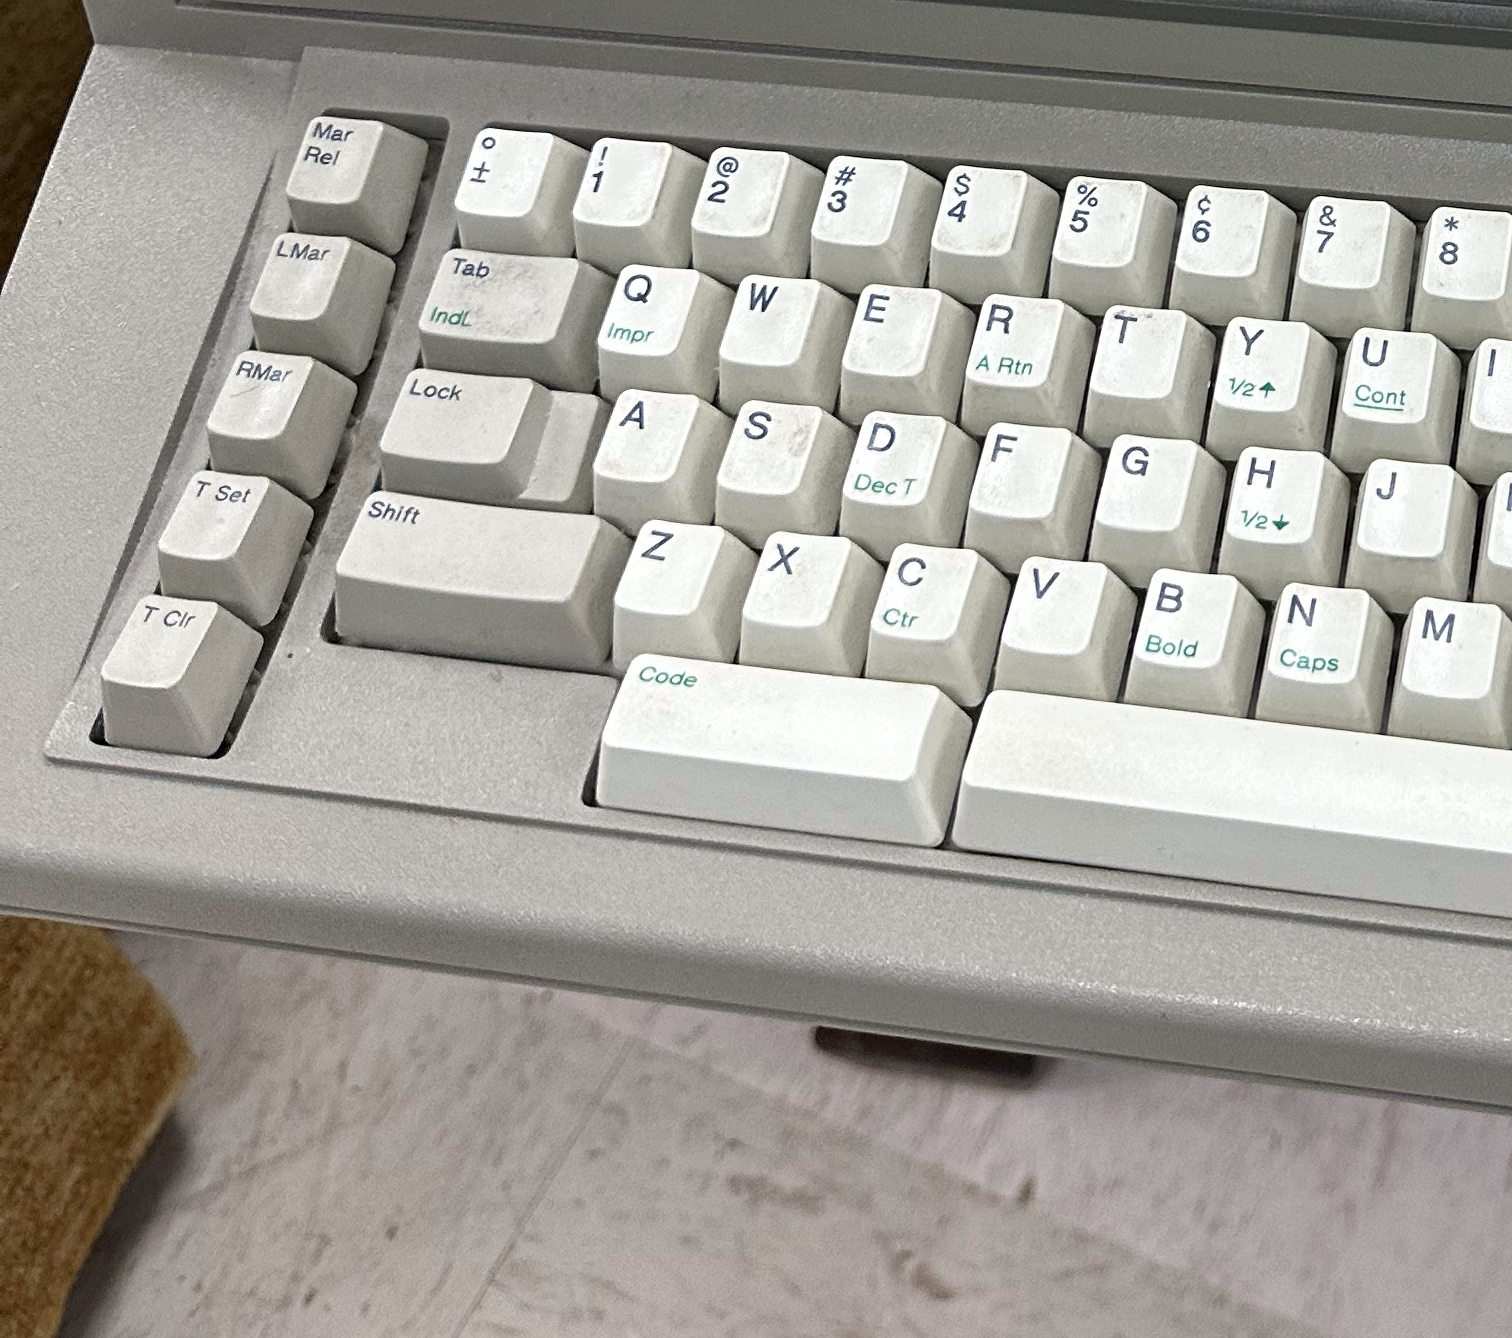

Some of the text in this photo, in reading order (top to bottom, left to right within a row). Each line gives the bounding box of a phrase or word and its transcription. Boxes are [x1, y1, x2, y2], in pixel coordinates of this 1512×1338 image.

[313, 123, 354, 141] Mar
[304, 146, 340, 165] Rel
[717, 157, 738, 177] @
[593, 171, 603, 192] 1
[835, 166, 856, 186] #
[954, 173, 971, 196] $
[707, 181, 729, 203] 2
[828, 190, 847, 212] 3
[1077, 185, 1098, 207] %
[948, 200, 967, 222] 4
[1070, 210, 1089, 233] 5
[1319, 205, 1336, 227] &
[1192, 220, 1211, 242] 6
[1317, 230, 1334, 253] 7
[276, 241, 330, 260] LMar
[1439, 242, 1458, 265] 8
[454, 258, 489, 278] Tab
[624, 275, 652, 303] Q
[750, 283, 778, 312] W
[863, 294, 890, 323] E
[986, 304, 1013, 334] R
[608, 323, 654, 344] Impr
[1114, 313, 1137, 343] T
[1240, 326, 1264, 355] Y
[1362, 337, 1388, 367] U
[236, 361, 293, 381] RMar
[976, 355, 1032, 375] A Rtn
[409, 379, 462, 401] Lock
[1354, 385, 1406, 411] Cont
[619, 401, 644, 429] A
[744, 412, 771, 440] S
[867, 423, 895, 451] D
[991, 434, 1018, 462] F
[1122, 446, 1149, 476] G
[1247, 457, 1276, 488] H
[197, 481, 251, 503] T Set
[854, 474, 917, 495] Dec T
[1376, 472, 1397, 499] J
[368, 501, 420, 524] Shift
[641, 530, 674, 561] Z
[768, 544, 800, 575] X
[898, 558, 926, 586] C
[1033, 568, 1060, 599] V
[1156, 582, 1183, 613] B
[144, 605, 160, 622] T
[883, 609, 918, 627] Ctr
[1288, 594, 1316, 627] N
[1422, 609, 1455, 643] M
[1146, 635, 1198, 657] Bold
[1280, 649, 1338, 673] Caps
[639, 667, 697, 687] Code
